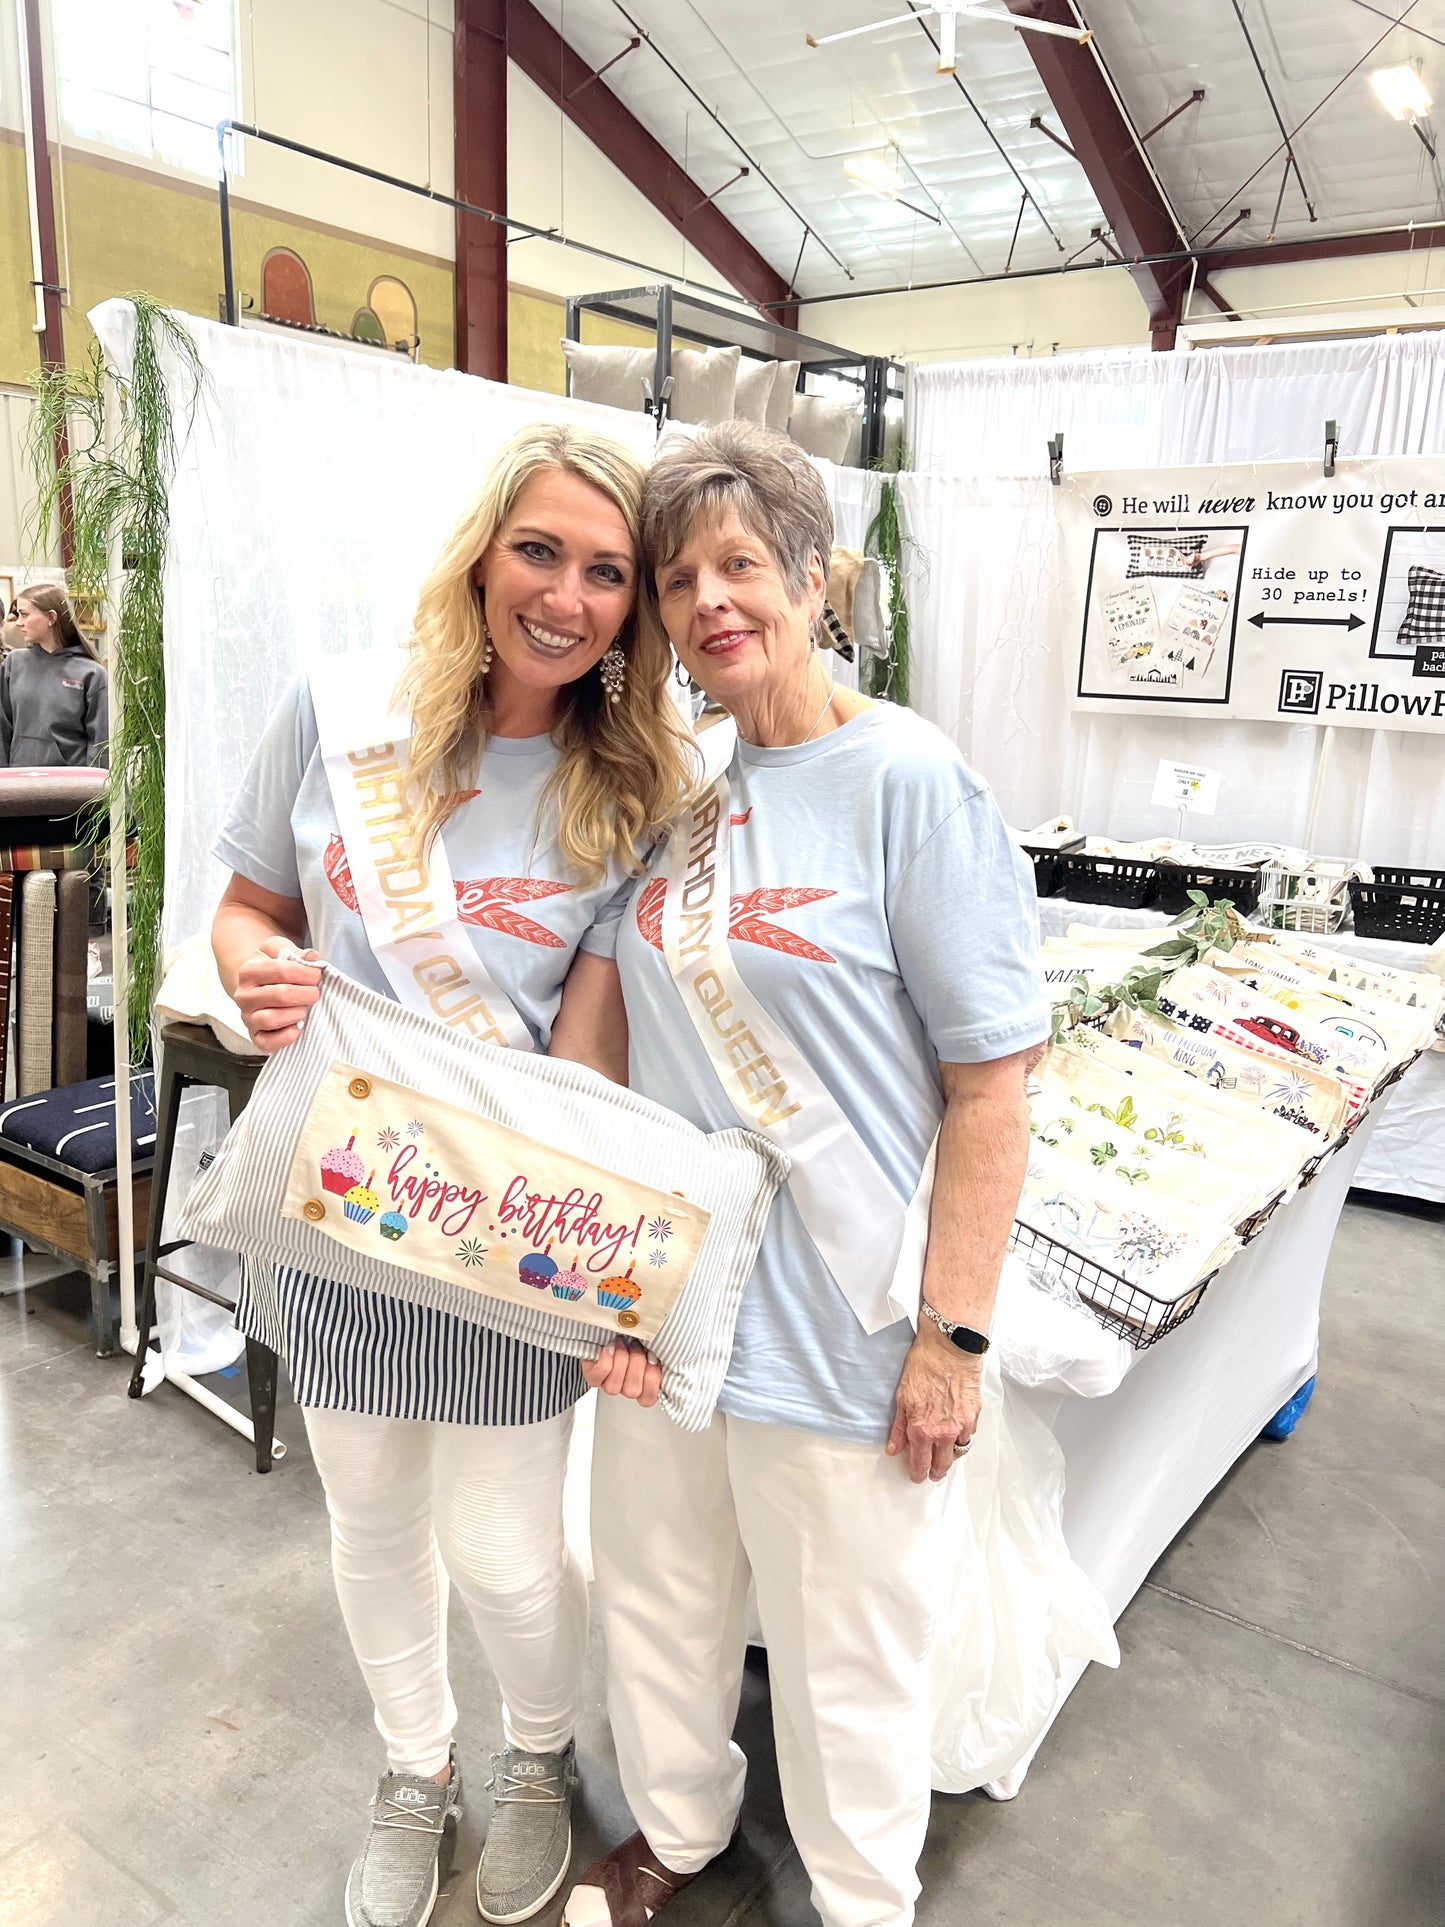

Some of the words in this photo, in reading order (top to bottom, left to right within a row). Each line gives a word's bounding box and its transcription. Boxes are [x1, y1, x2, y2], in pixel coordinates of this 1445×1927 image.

[1122, 497, 1148, 514] He
[1153, 494, 1190, 513] will
[1198, 495, 1256, 515] never
[1266, 490, 1327, 511] know
[1333, 493, 1374, 514] you
[1380, 490, 1418, 513] got
[1252, 567, 1296, 580] Hide
[1308, 569, 1329, 583] up
[1341, 568, 1362, 580] to
[1261, 588, 1282, 601] 30
[1293, 588, 1367, 604] panels!
[693, 968, 802, 1129] QUEEN
[388, 1145, 489, 1237] happy
[497, 1176, 645, 1273] birthday!
